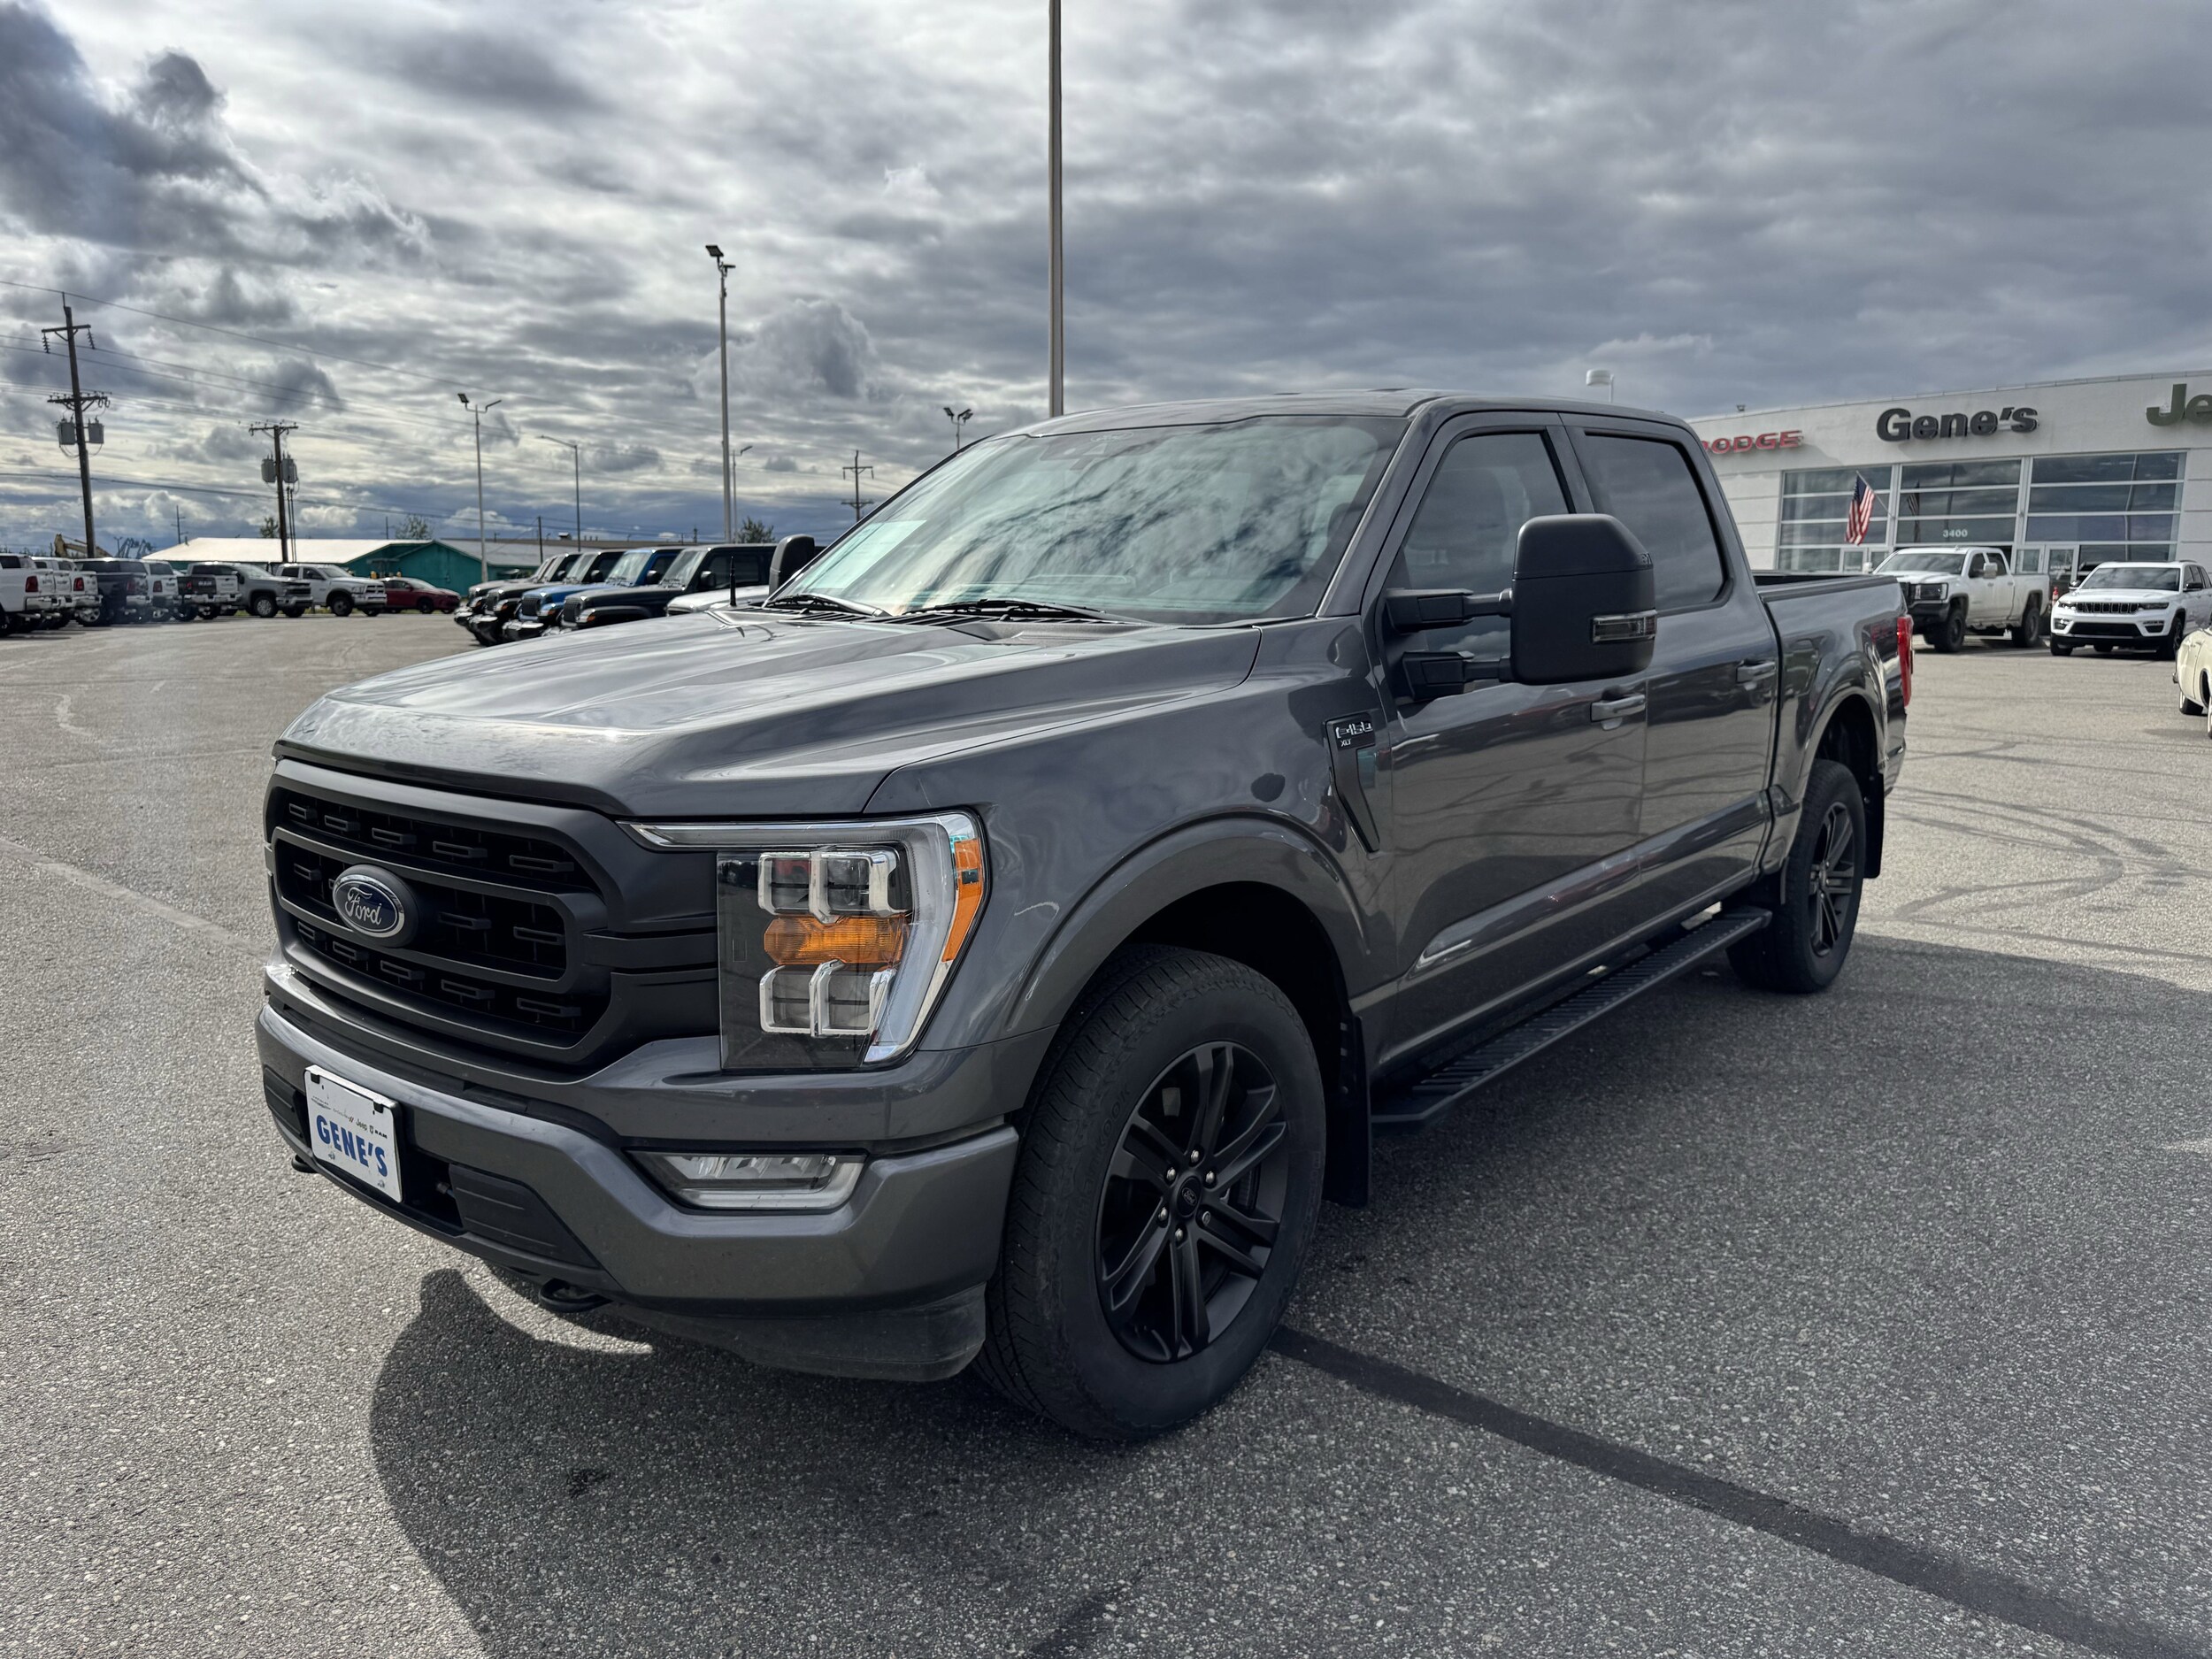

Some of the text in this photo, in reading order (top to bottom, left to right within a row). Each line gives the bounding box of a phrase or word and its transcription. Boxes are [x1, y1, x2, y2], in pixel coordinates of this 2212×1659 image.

[1876, 407, 2039, 442] Gene's
[1942, 528, 1969, 538] 3400
[344, 887, 382, 926] Ford
[316, 1114, 388, 1178] GENE'S
[374, 1129, 388, 1140] RAM
